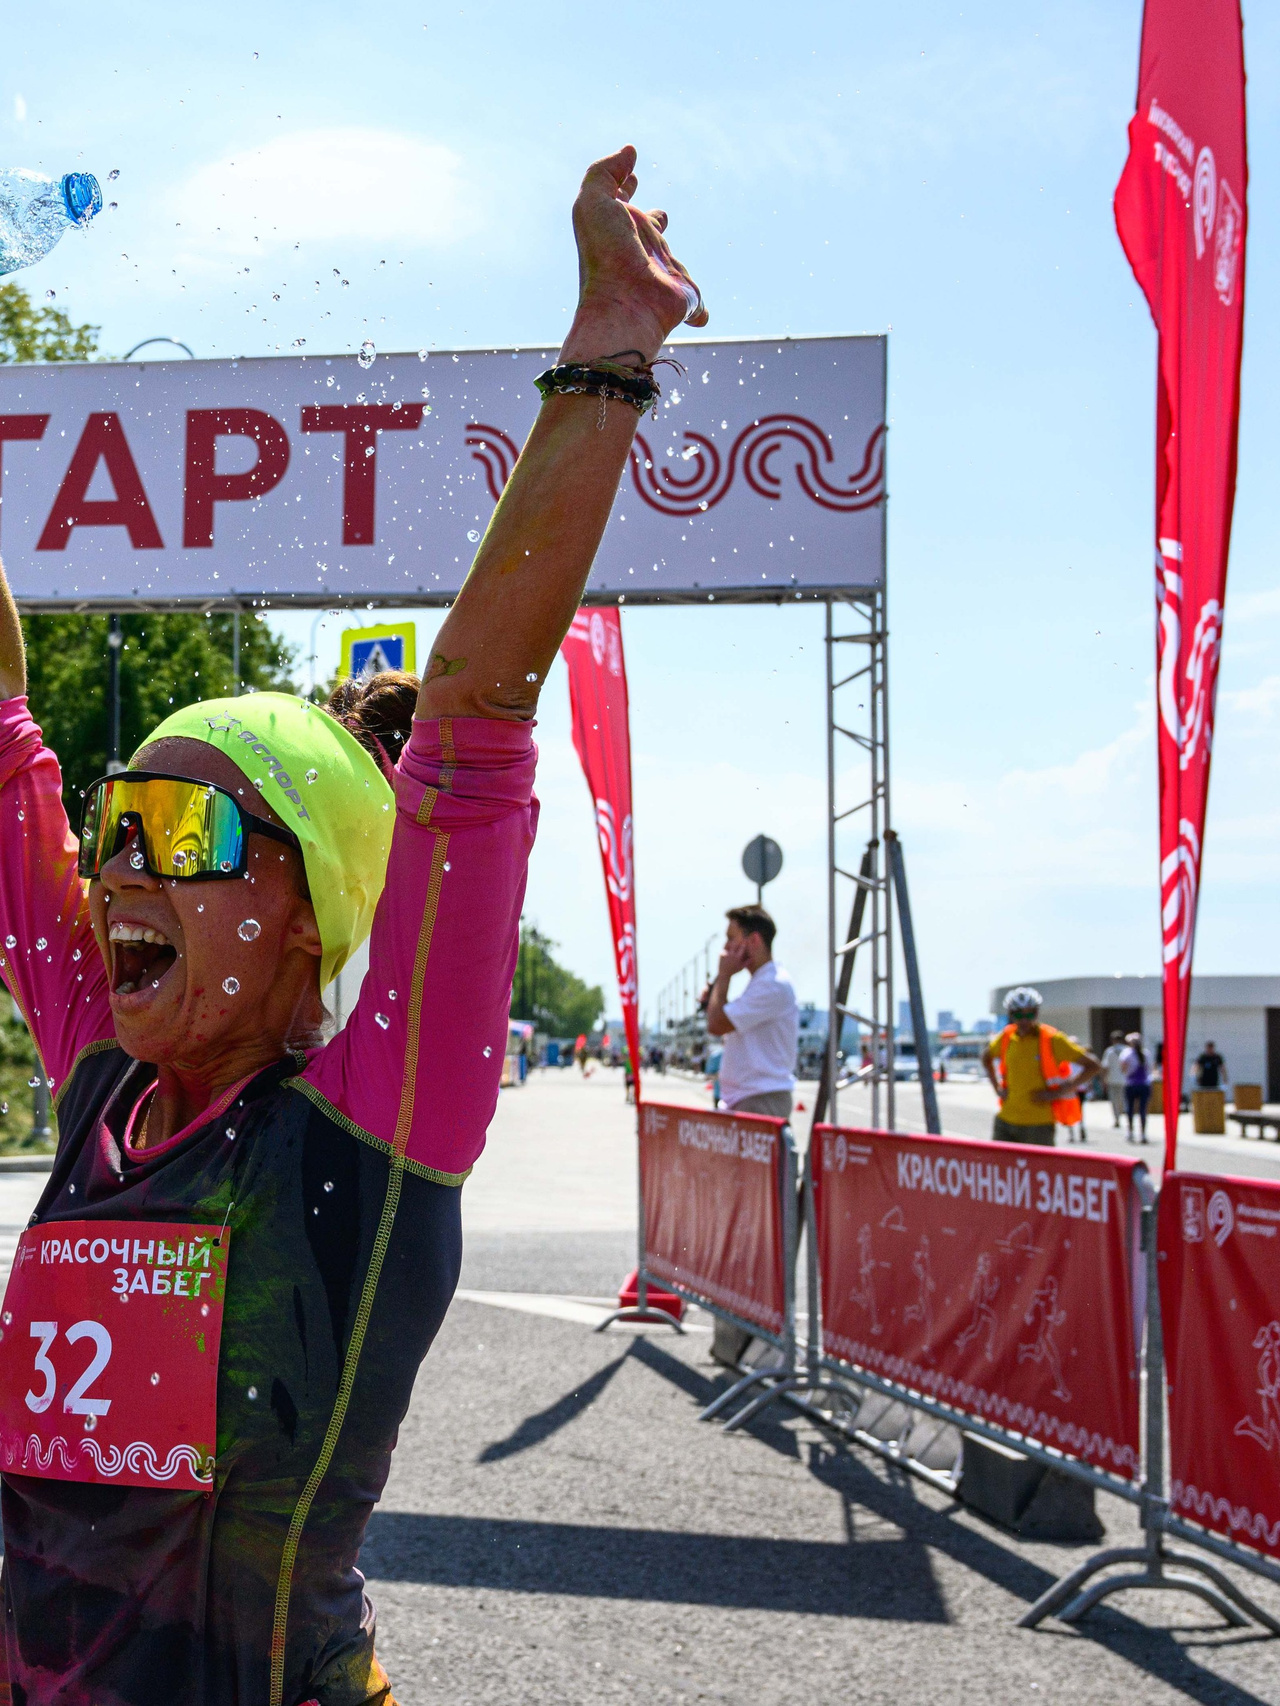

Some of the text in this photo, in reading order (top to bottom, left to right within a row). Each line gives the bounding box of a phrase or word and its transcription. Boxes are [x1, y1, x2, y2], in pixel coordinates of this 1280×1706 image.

[897, 1151, 1118, 1223] КРАСОЧНЫЙ ЗАБЕГ
[40, 1236, 210, 1268] КРАСОЧНЫЙ
[111, 1268, 211, 1297] ЗАБЕГ
[24, 1320, 112, 1416] 32
